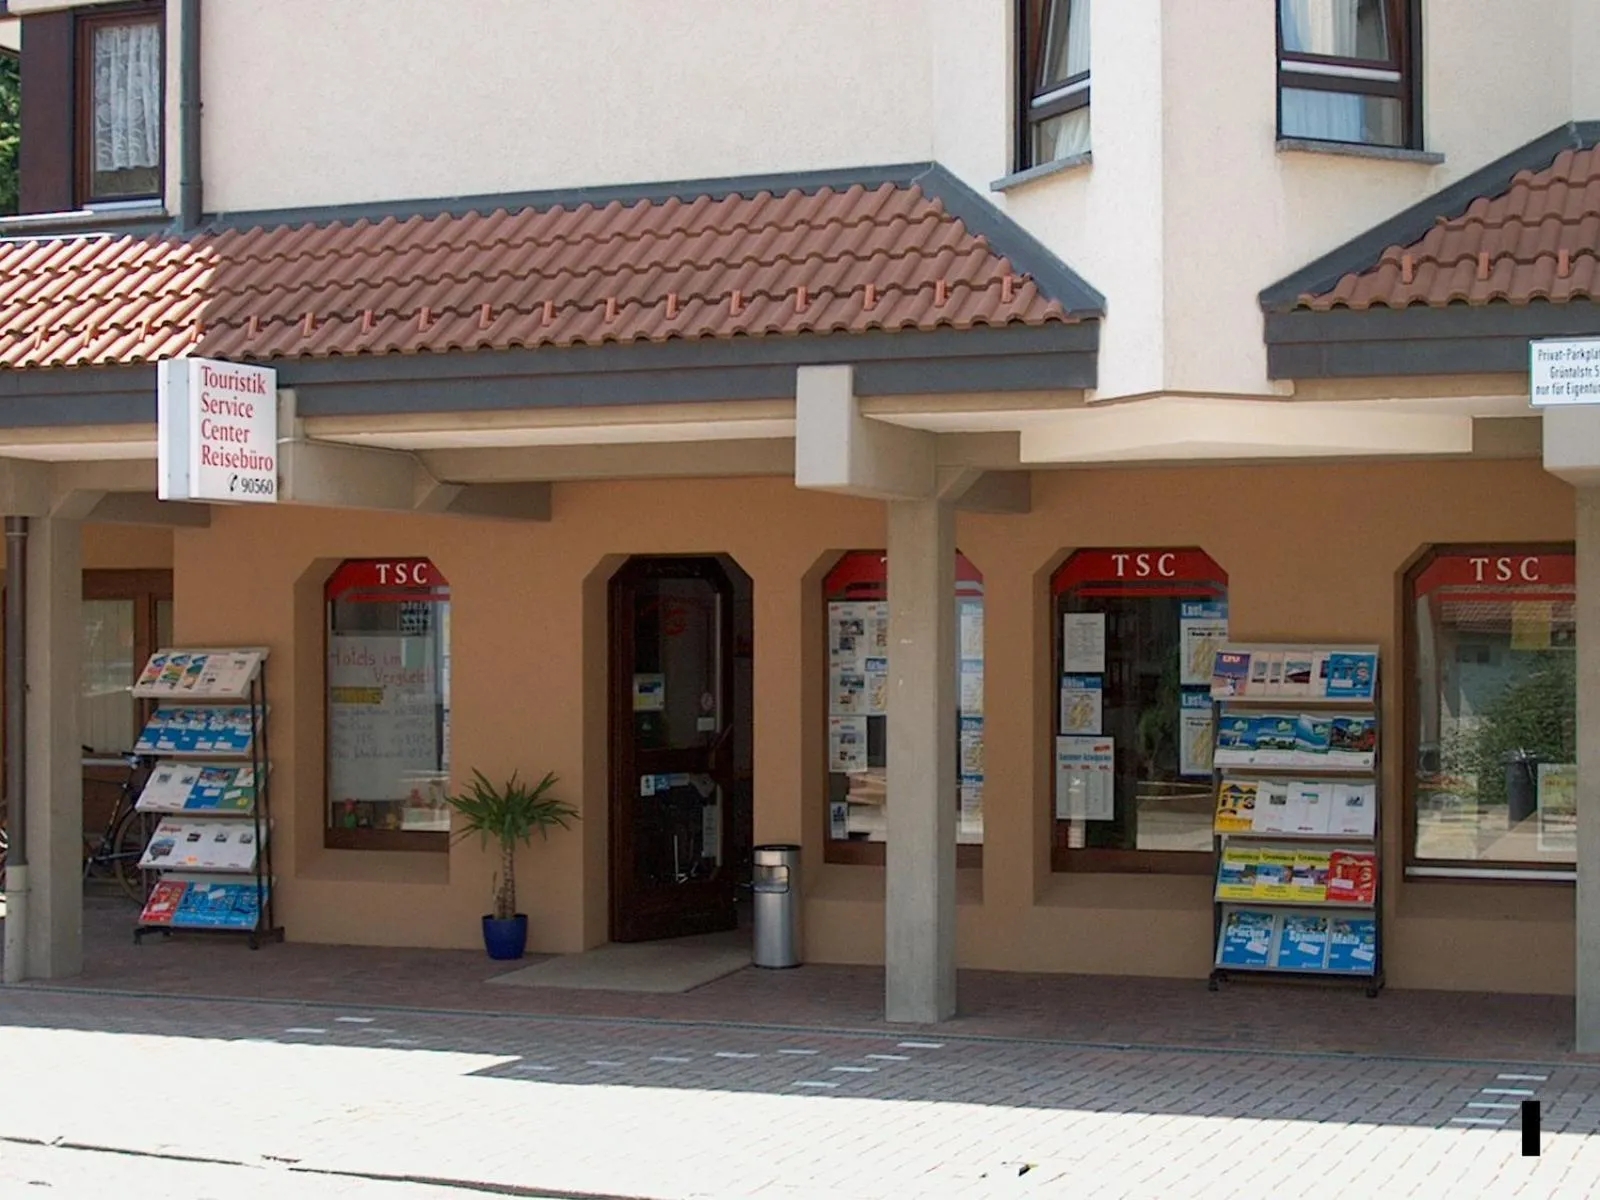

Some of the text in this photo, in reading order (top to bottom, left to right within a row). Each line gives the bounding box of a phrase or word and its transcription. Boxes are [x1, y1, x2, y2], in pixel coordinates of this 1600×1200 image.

[1538, 348, 1600, 363] Privat-Parkpla
[201, 366, 266, 394] Touristik
[201, 392, 254, 418] Service
[201, 418, 250, 443] Center
[201, 445, 273, 471] Reisebüro
[241, 478, 273, 495] 90560
[375, 562, 428, 585] TSC
[1111, 553, 1176, 577] TSC
[1469, 556, 1540, 582] TSC
